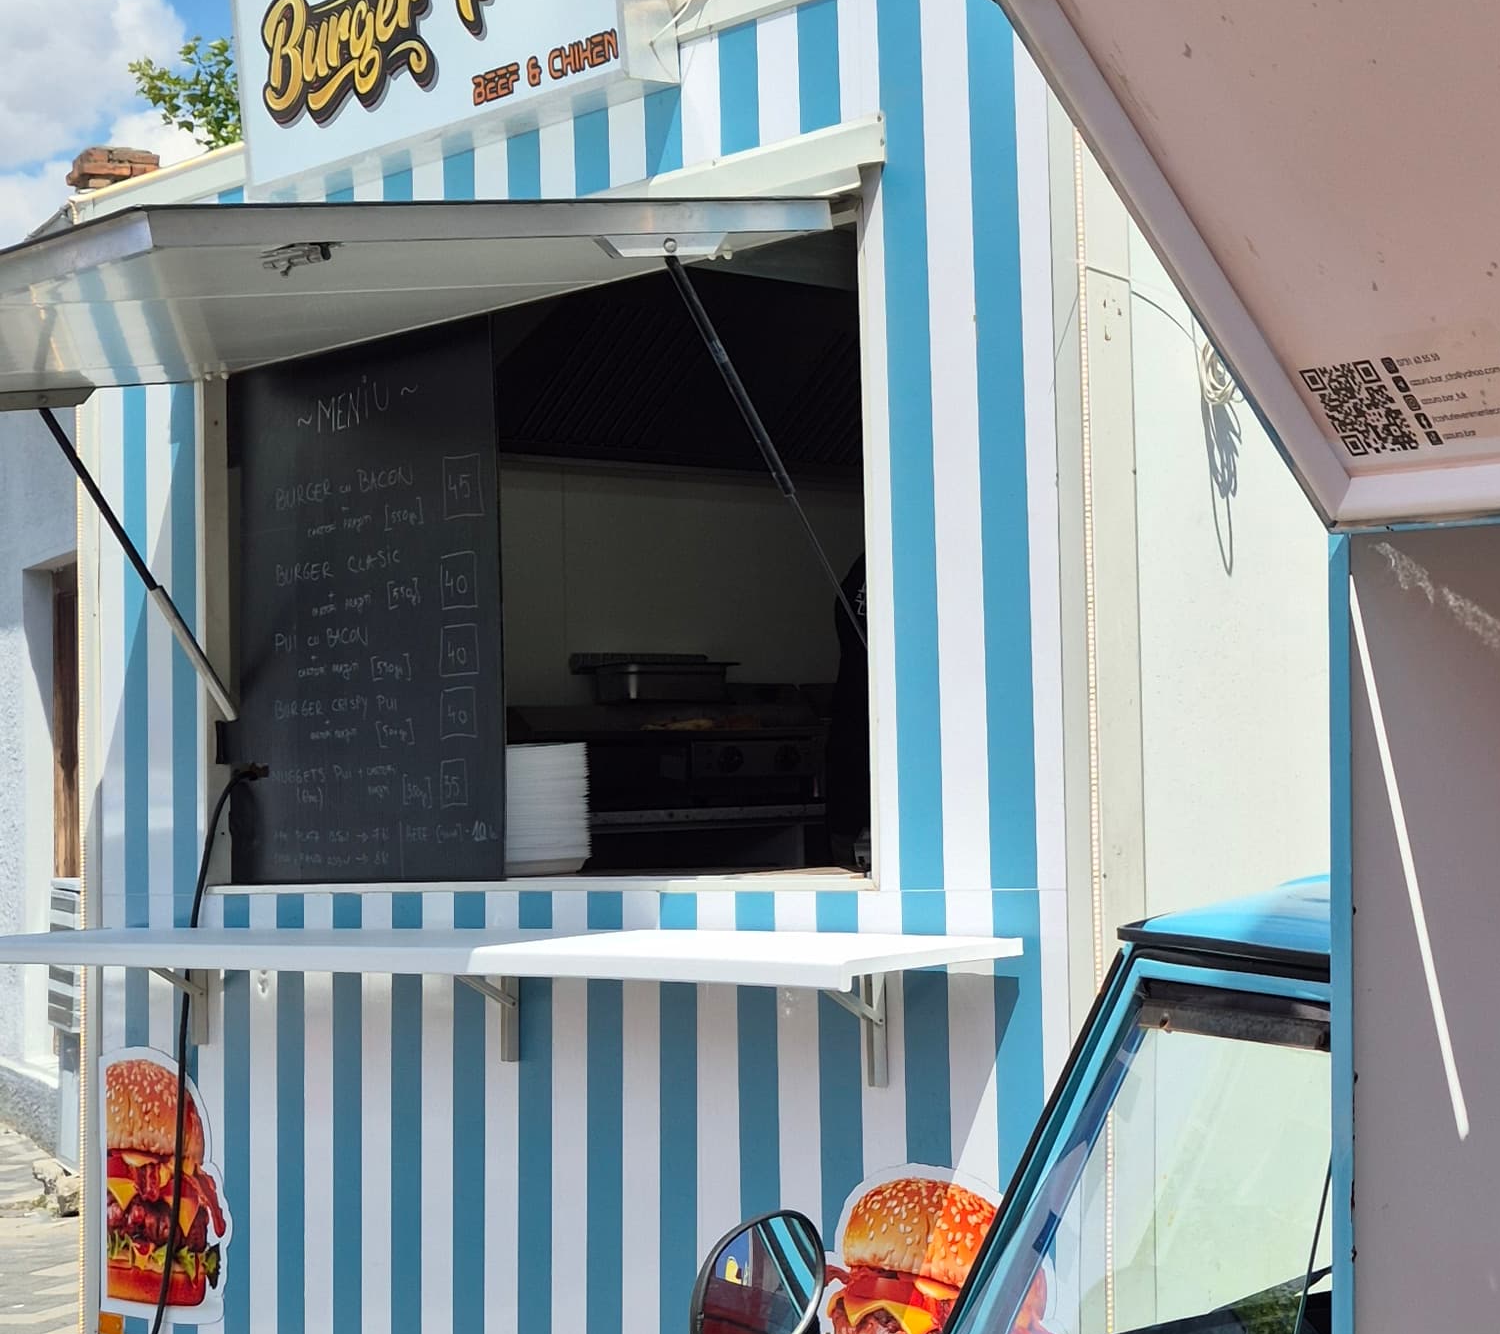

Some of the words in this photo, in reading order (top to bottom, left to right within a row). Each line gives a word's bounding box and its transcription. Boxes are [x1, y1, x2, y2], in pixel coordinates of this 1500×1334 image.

[472, 63, 520, 106] BEEF
[527, 55, 542, 87] &
[447, 473, 472, 501] 45
[444, 569, 468, 597] 40
[447, 641, 467, 665] 40
